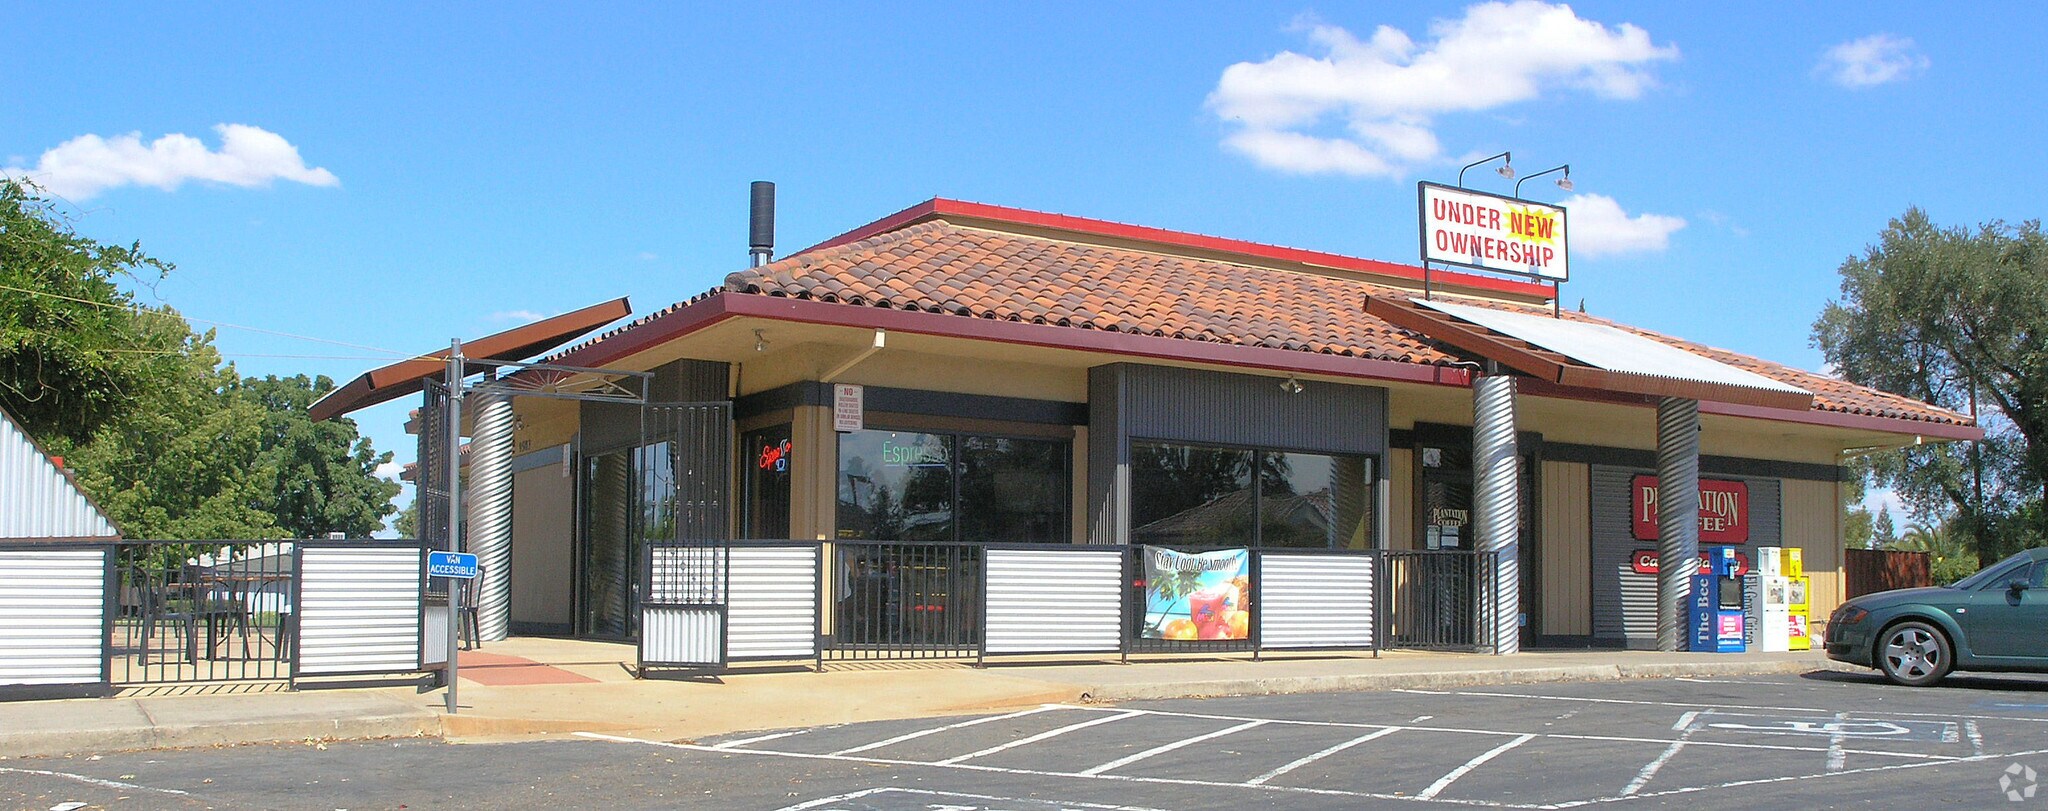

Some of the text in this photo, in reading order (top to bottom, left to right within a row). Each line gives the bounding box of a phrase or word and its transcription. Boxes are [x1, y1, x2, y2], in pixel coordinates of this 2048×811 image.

[1434, 198, 1553, 239] UNDER NEW
[1436, 229, 1553, 267] OWNERSHIP
[843, 387, 854, 396] NO
[883, 441, 949, 466] Espresso
[1433, 508, 1468, 524] PLANTATION
[1642, 486, 1738, 526] PTION
[430, 564, 475, 576] ACCESSIBLE
[446, 555, 461, 564] VAN
[1697, 578, 1709, 644] The Bee
[1744, 616, 1758, 645] Citizen
